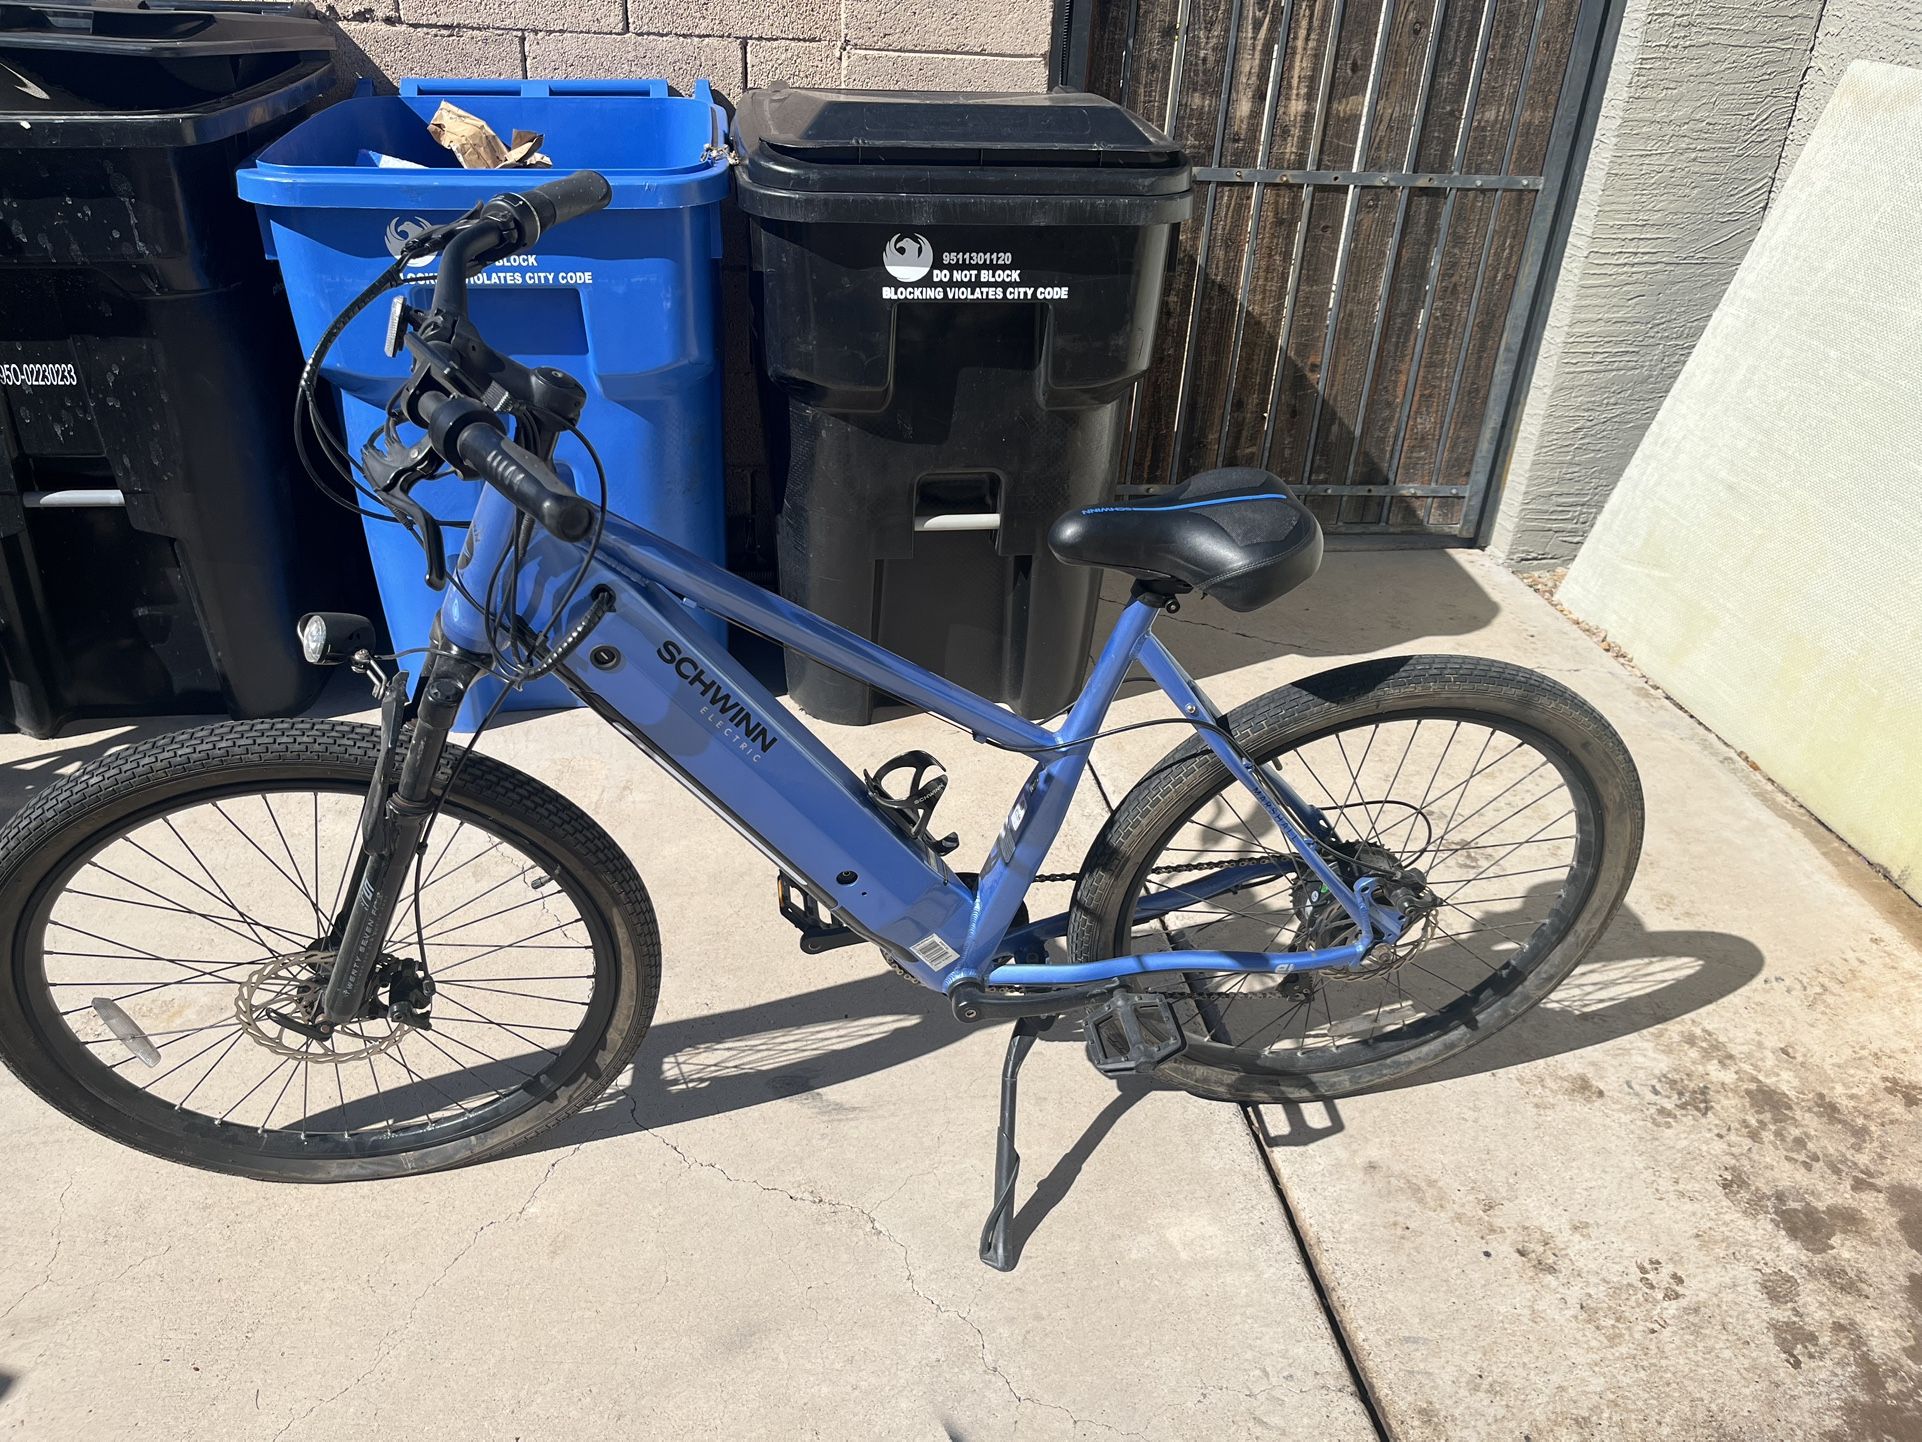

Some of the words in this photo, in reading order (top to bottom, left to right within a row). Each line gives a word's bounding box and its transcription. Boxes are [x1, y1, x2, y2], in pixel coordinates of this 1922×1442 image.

[942, 252, 1012, 265] 9511301120
[525, 272, 555, 284] CITY
[558, 272, 593, 284] CODE
[932, 269, 950, 282] DO
[953, 269, 978, 282] NOT
[980, 269, 1020, 282] BLOCK
[882, 287, 944, 299] BLOCKING
[947, 287, 1004, 299] VIOLATES
[1006, 287, 1034, 299] CITY
[1036, 286, 1069, 299] CODE
[656, 640, 778, 753] SCHWINN
[699, 706, 762, 763] ELECTRIC
[913, 783, 945, 804] SCHWINN
[1252, 786, 1299, 842] MARSHALL
[344, 954, 362, 997] TWENTY
[358, 917, 375, 952] SEVEN
